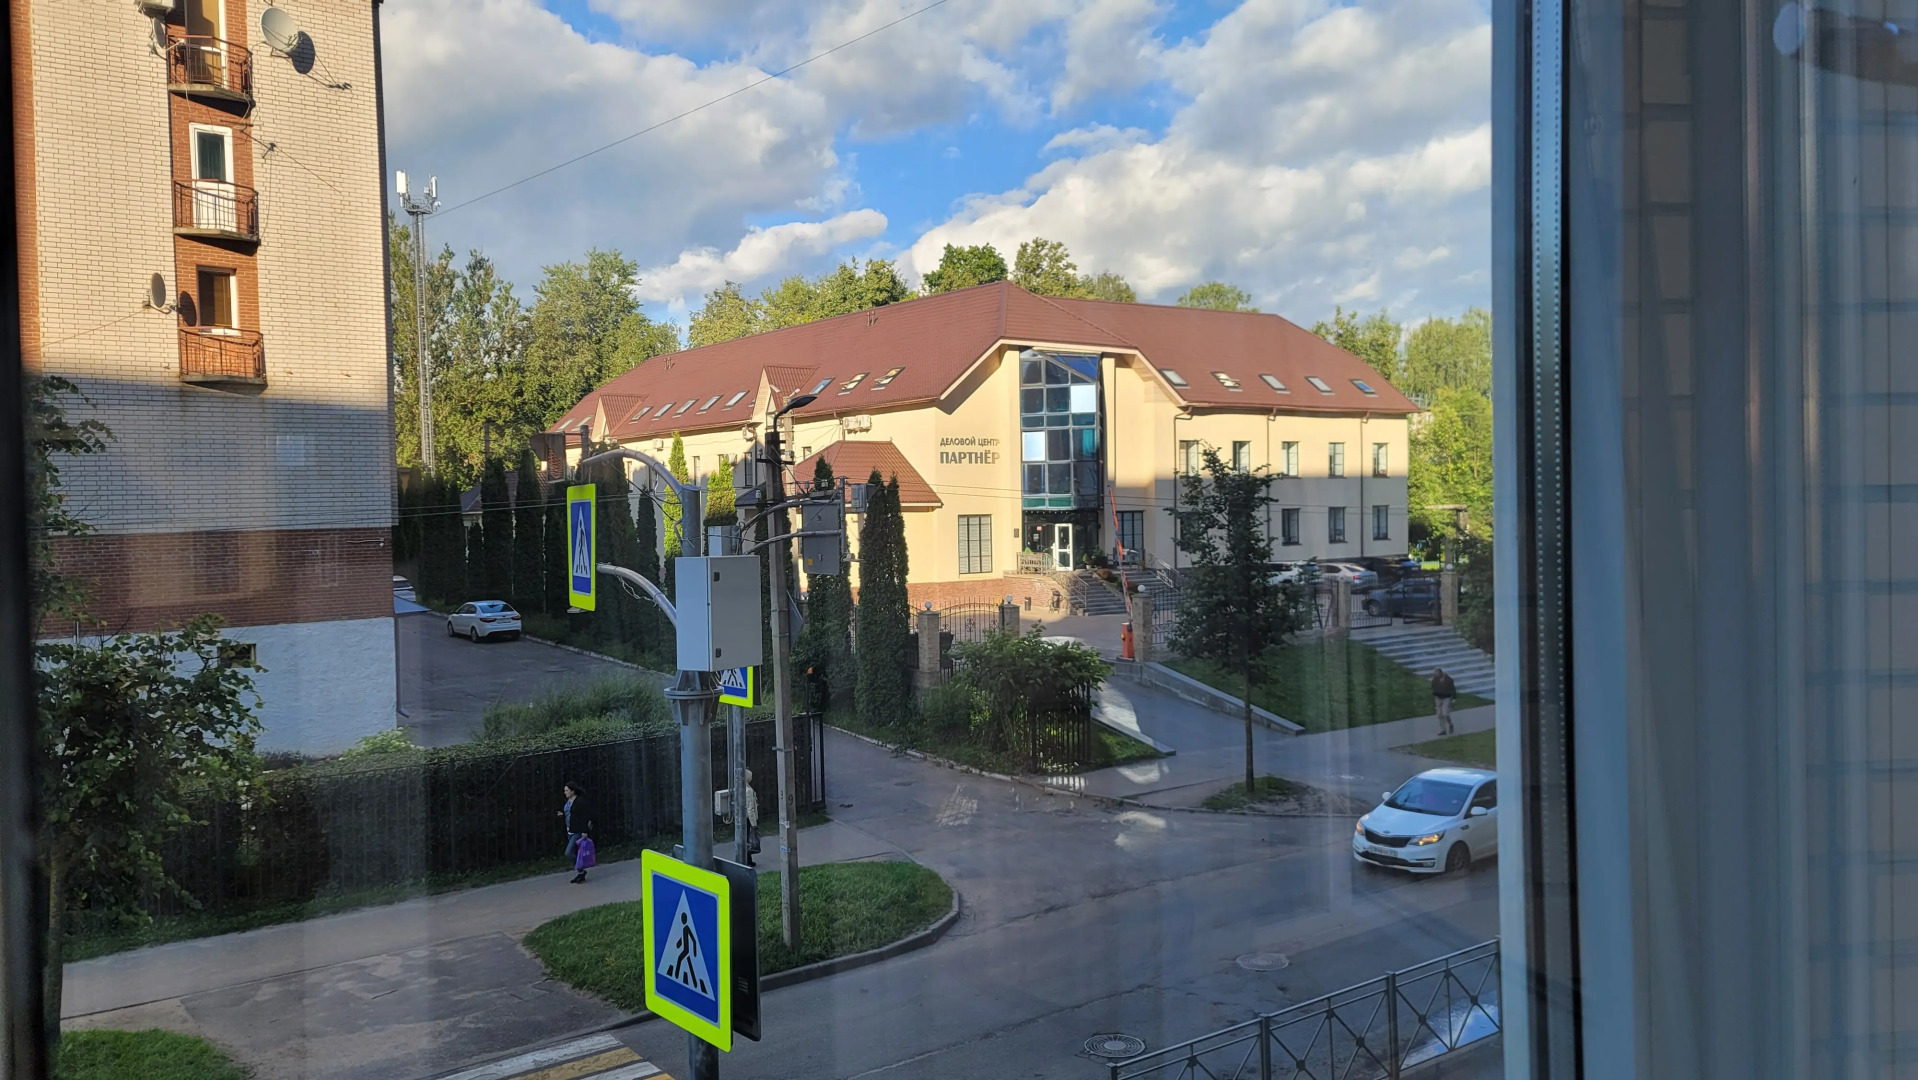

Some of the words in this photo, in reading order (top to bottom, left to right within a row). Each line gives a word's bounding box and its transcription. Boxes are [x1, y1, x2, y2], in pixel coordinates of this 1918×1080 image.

[940, 437, 976, 446] ДЕЛОВОЙ
[978, 438, 1000, 447] ЦЕНТР
[940, 450, 1000, 464] ПАРТНЁР
